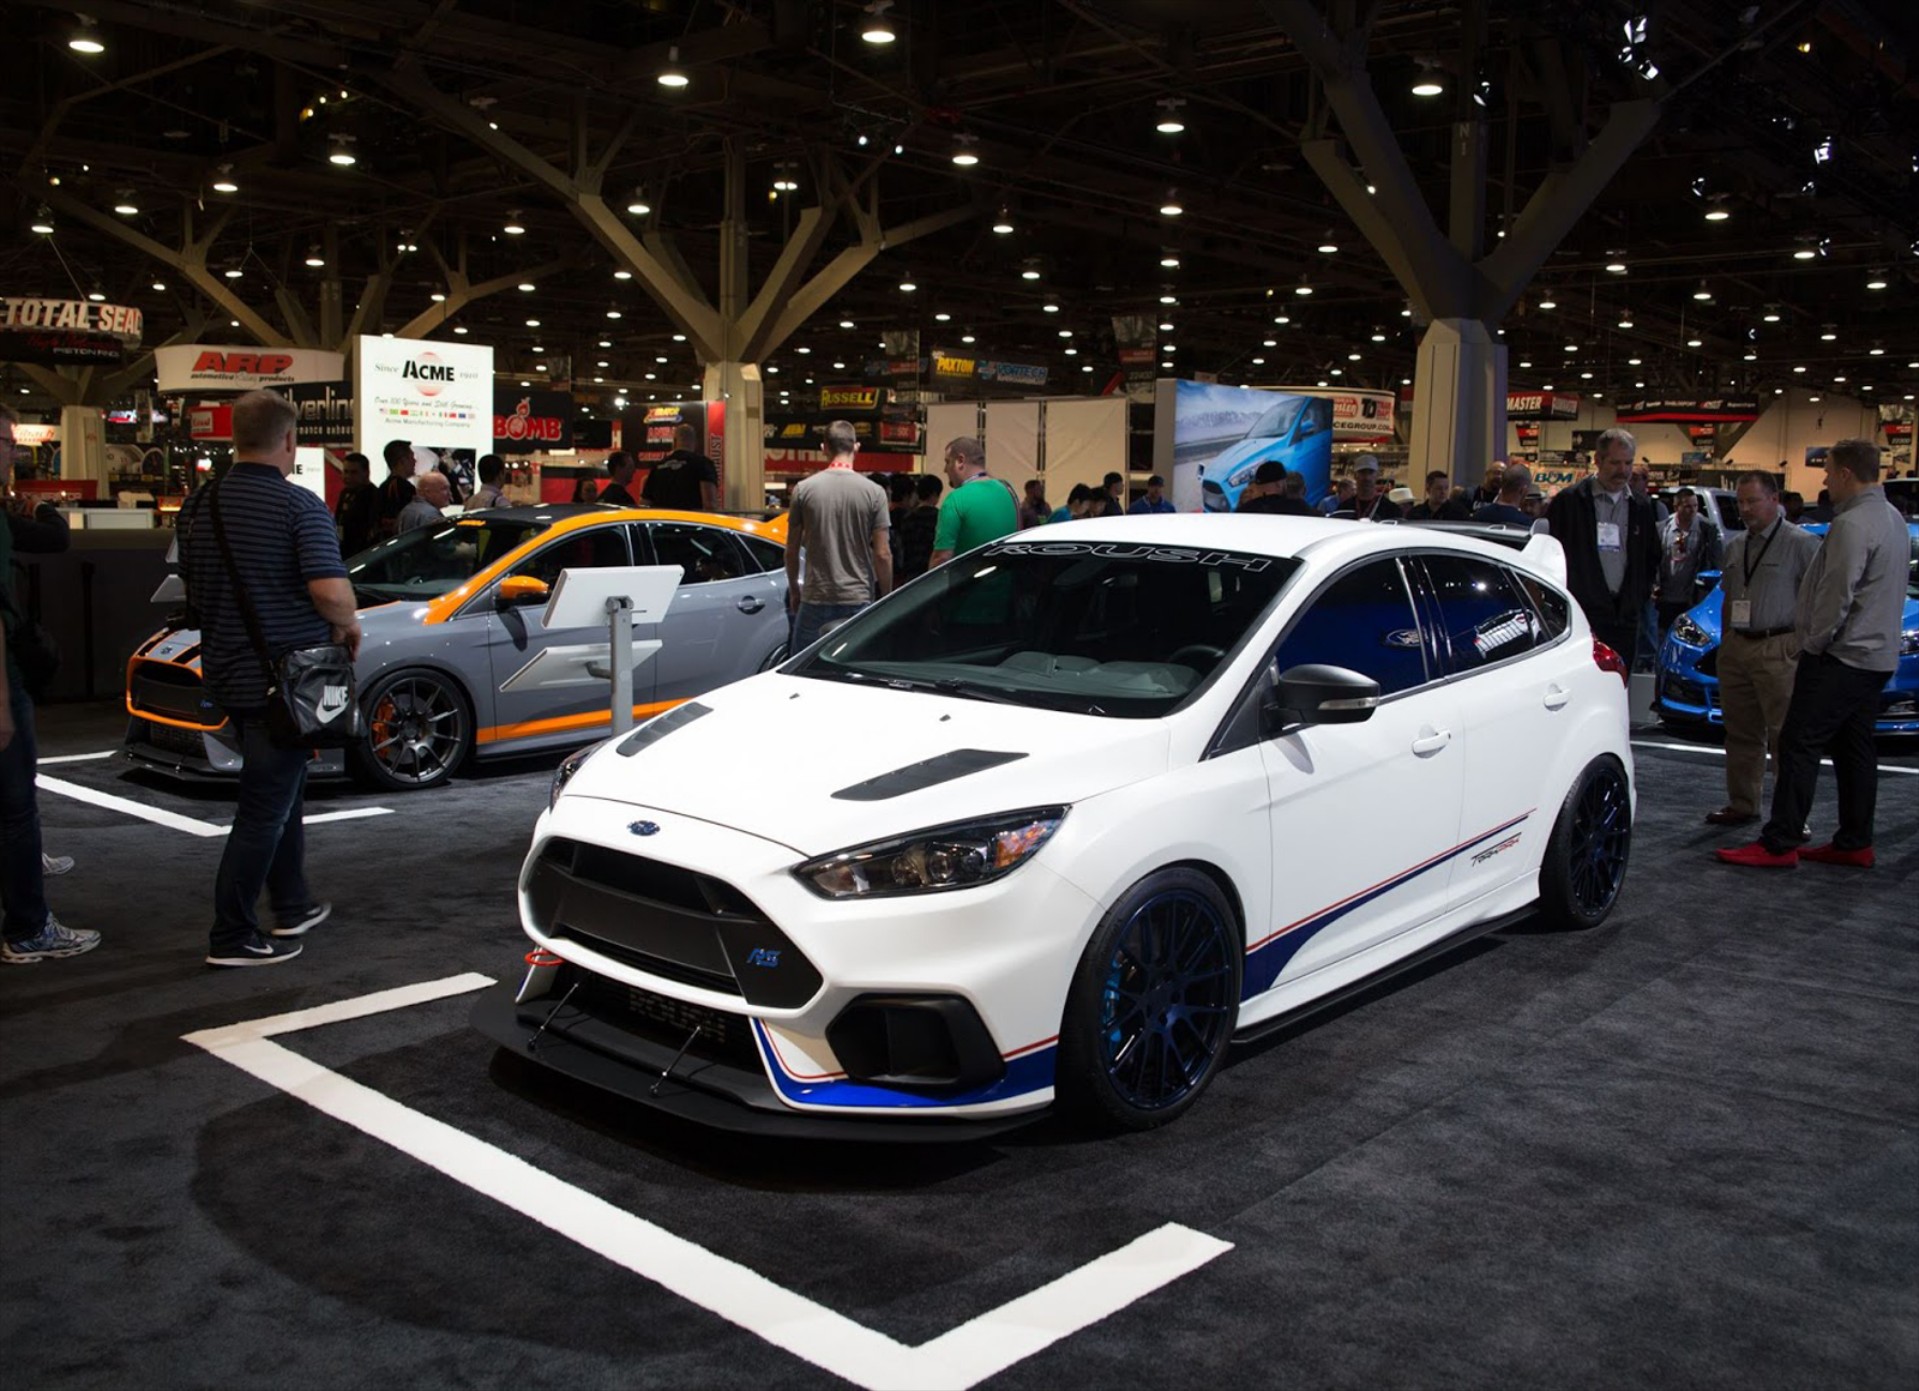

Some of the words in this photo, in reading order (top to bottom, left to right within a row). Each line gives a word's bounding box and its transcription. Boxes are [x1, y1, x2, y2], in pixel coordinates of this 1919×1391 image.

[4, 298, 91, 329] TOTAL
[98, 304, 142, 335] SEAL
[191, 351, 294, 374] ARP
[374, 362, 399, 374] Since
[402, 360, 456, 382] ACME
[937, 356, 975, 373] PAXTON
[259, 375, 295, 383] products
[820, 389, 875, 407] RUSSELL
[1506, 396, 1543, 411] MASTER
[493, 414, 562, 441] BOMB
[1333, 421, 1390, 431] CEGROUP.COM
[983, 543, 1272, 572] ROUSH
[324, 685, 348, 706] NIKE
